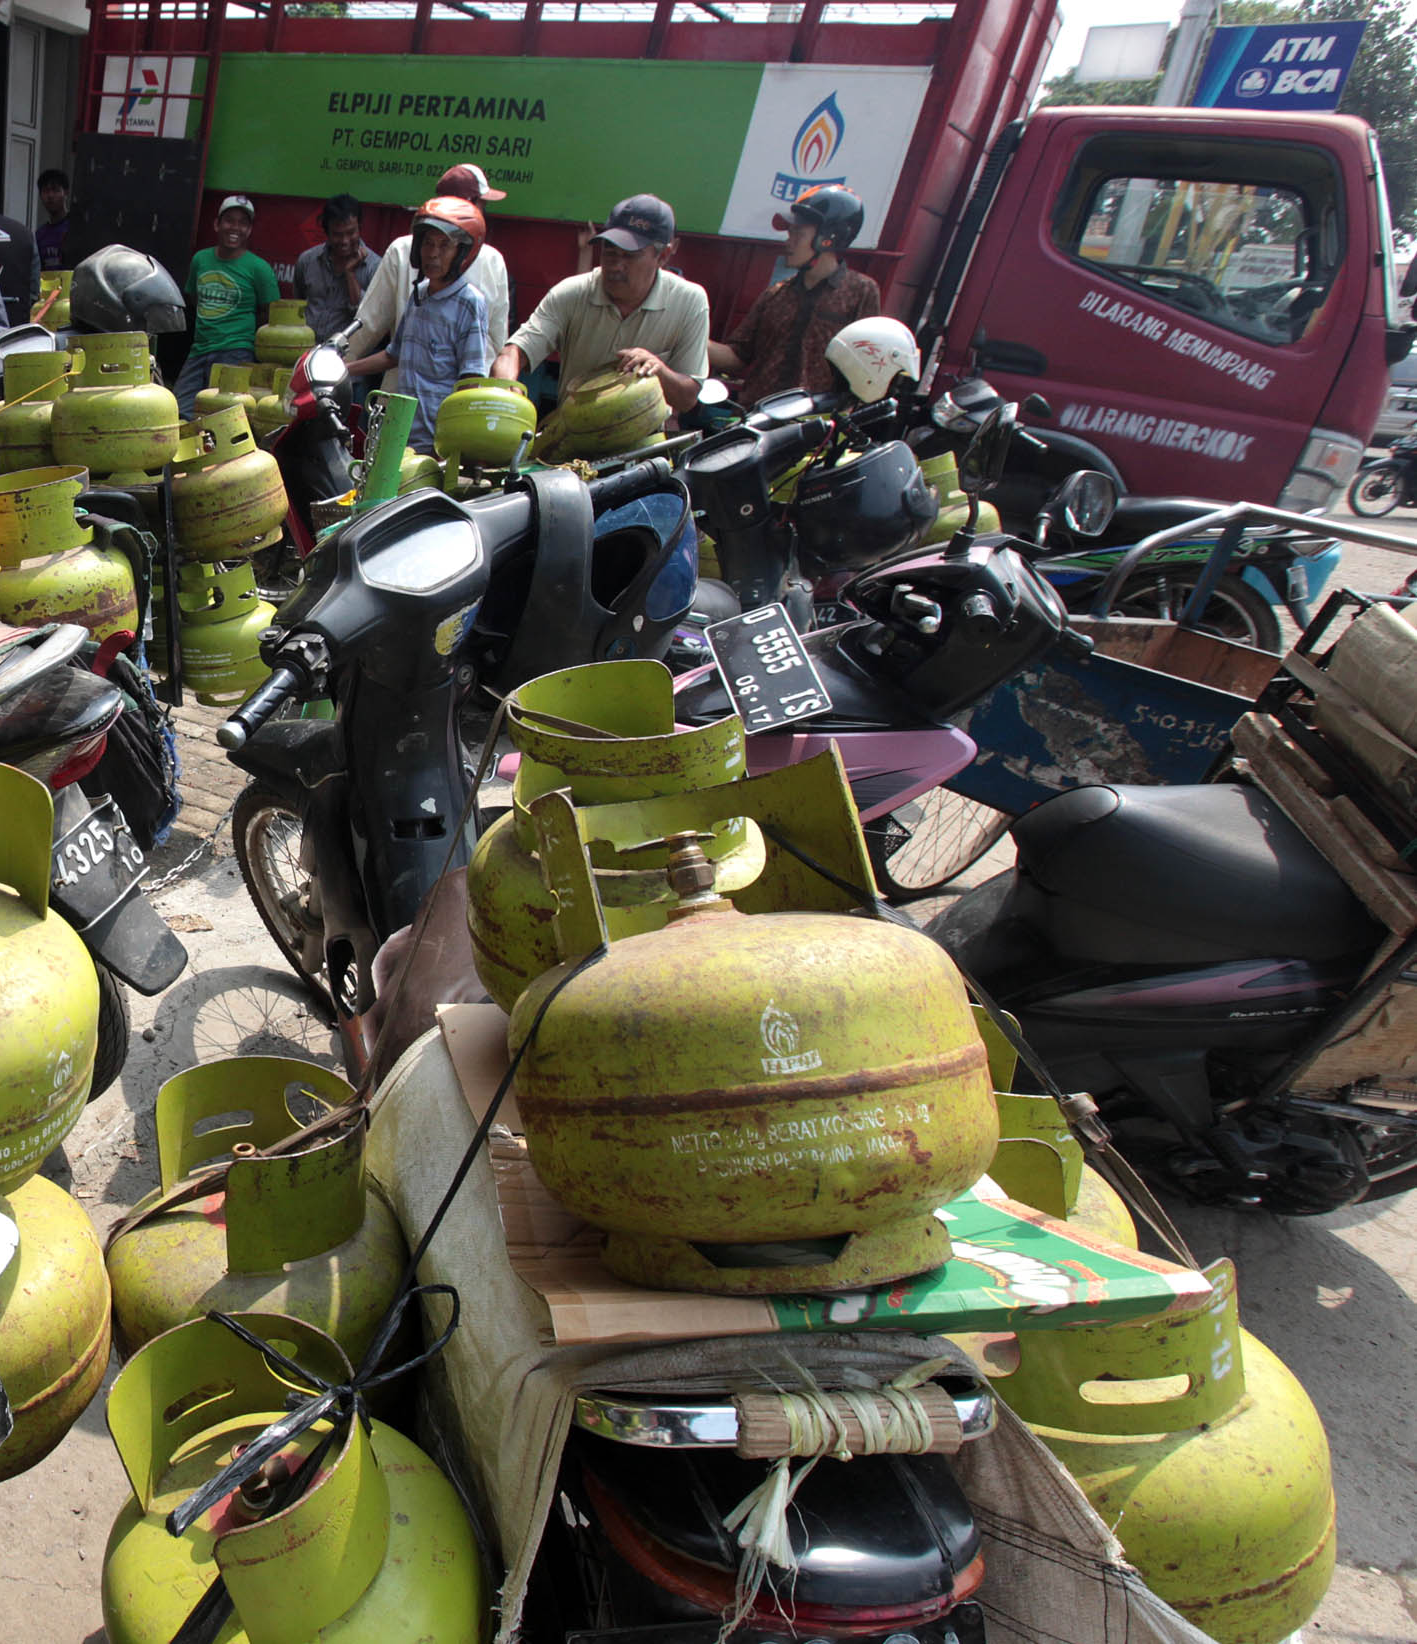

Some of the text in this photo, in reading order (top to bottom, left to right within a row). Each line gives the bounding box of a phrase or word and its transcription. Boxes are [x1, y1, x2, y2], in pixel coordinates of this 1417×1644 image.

[1260, 36, 1336, 63] ATM
[1269, 68, 1342, 94] BCA
[328, 91, 547, 122] ELPIJI PERTAMINA
[332, 127, 533, 158] PT. GEMPOL ASRI SARI
[336, 158, 375, 172] GEMPOL
[1079, 291, 1277, 391] DILARANG MENUMPANG
[1060, 403, 1256, 463] DILARANG MEROKOK
[742, 608, 777, 625] D
[751, 627, 804, 674] 5555
[55, 818, 115, 885] 4325
[767, 1116, 819, 1146] BERAT
[820, 1106, 887, 1136] KOSONG
